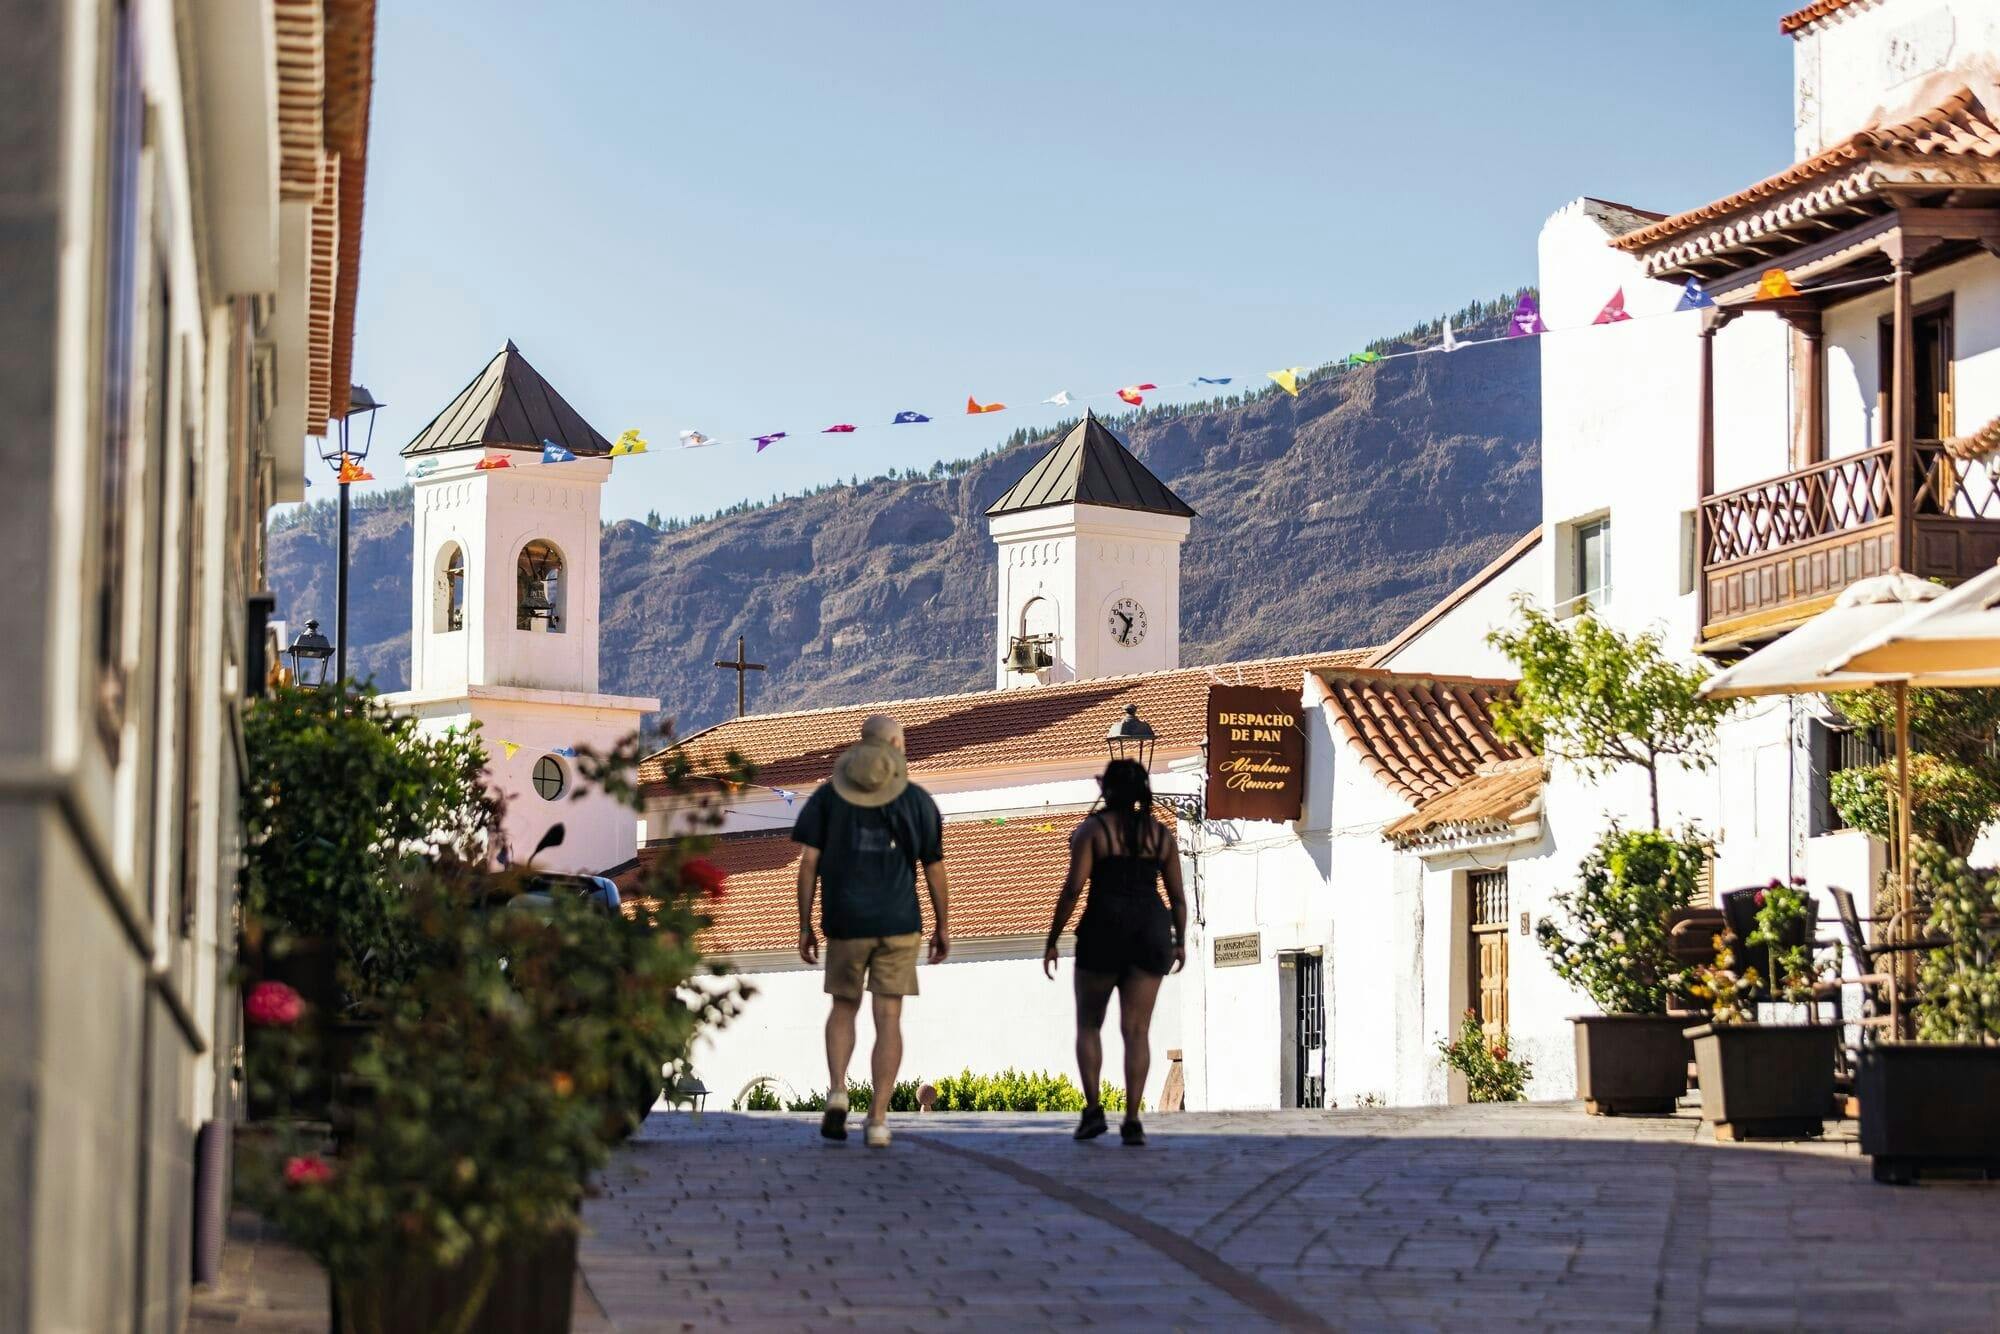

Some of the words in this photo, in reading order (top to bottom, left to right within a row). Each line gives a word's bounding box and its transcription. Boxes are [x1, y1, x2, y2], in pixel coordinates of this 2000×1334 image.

[1219, 712, 1294, 727] DESPACHO
[1231, 729, 1250, 741] DE
[1253, 729, 1281, 742] PAN
[1219, 757, 1291, 774] Abraham
[1226, 773, 1286, 792] Romero
